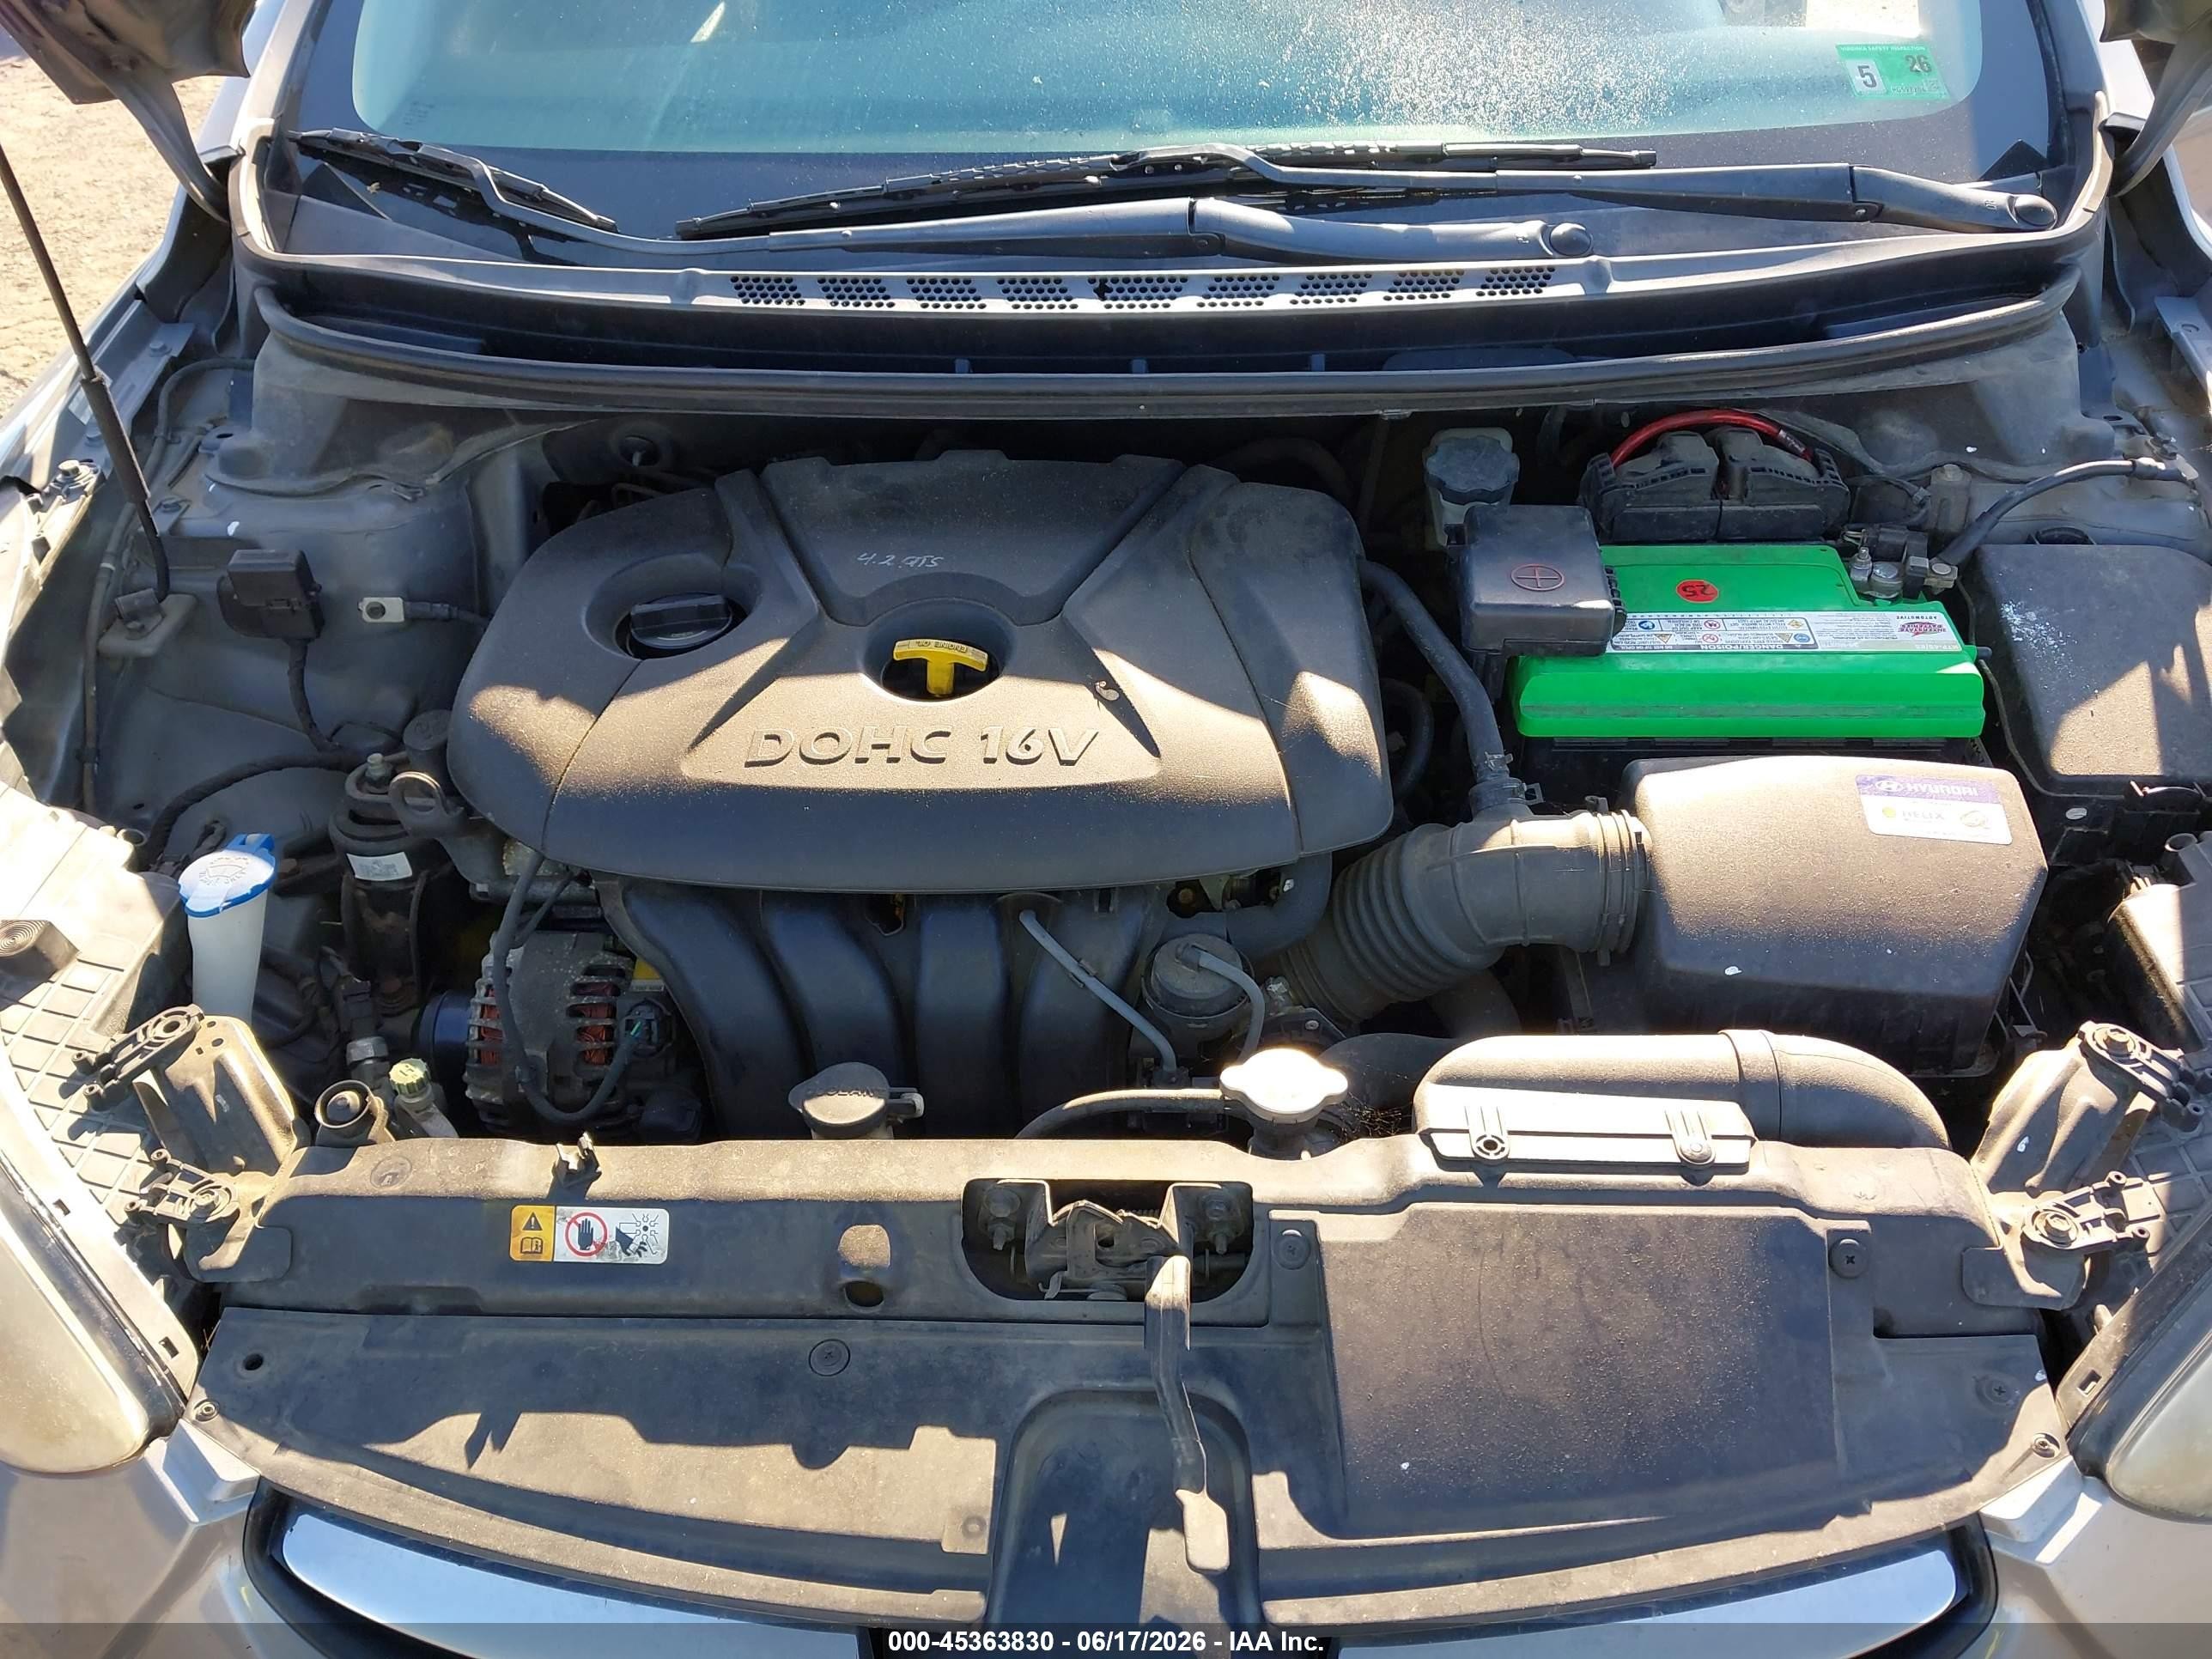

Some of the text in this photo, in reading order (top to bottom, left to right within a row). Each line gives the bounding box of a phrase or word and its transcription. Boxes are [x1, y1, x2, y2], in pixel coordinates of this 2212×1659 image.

[1905, 54, 1932, 73] 26
[1857, 64, 1877, 88] 5
[1681, 584, 1715, 598] 25
[744, 724, 1100, 768] DOHC 16V
[1903, 781, 1979, 797] HYUNDAI
